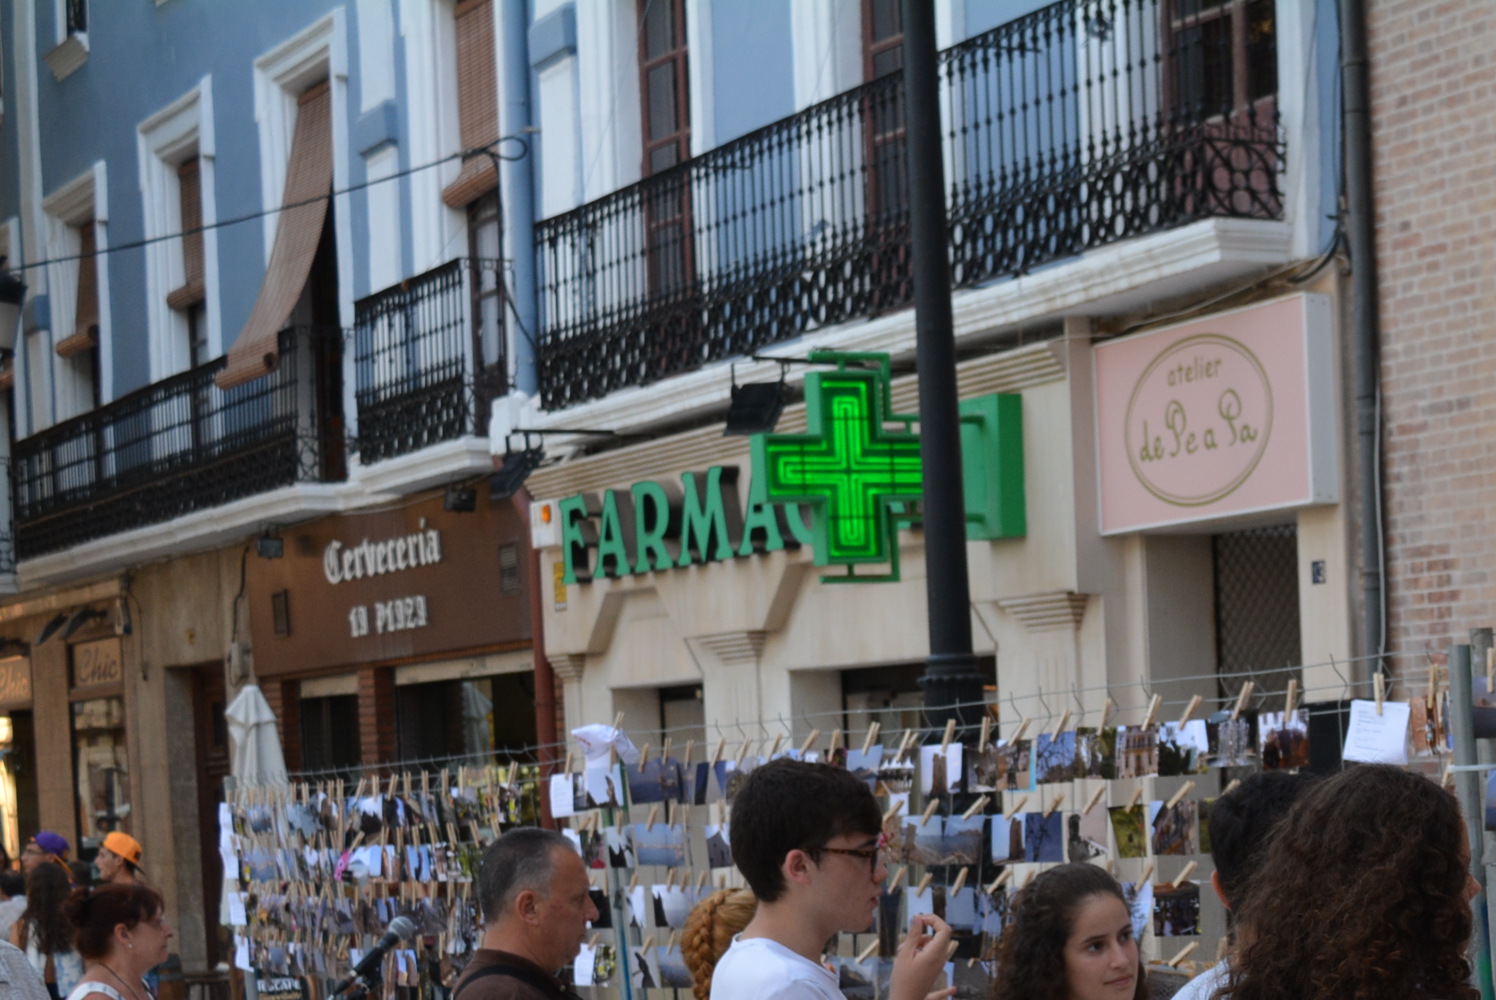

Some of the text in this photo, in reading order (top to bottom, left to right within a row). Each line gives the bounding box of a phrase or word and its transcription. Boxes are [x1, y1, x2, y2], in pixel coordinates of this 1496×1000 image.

[1167, 356, 1223, 387] atelier
[1139, 419, 1165, 463] de
[323, 517, 441, 585] Cervecería
